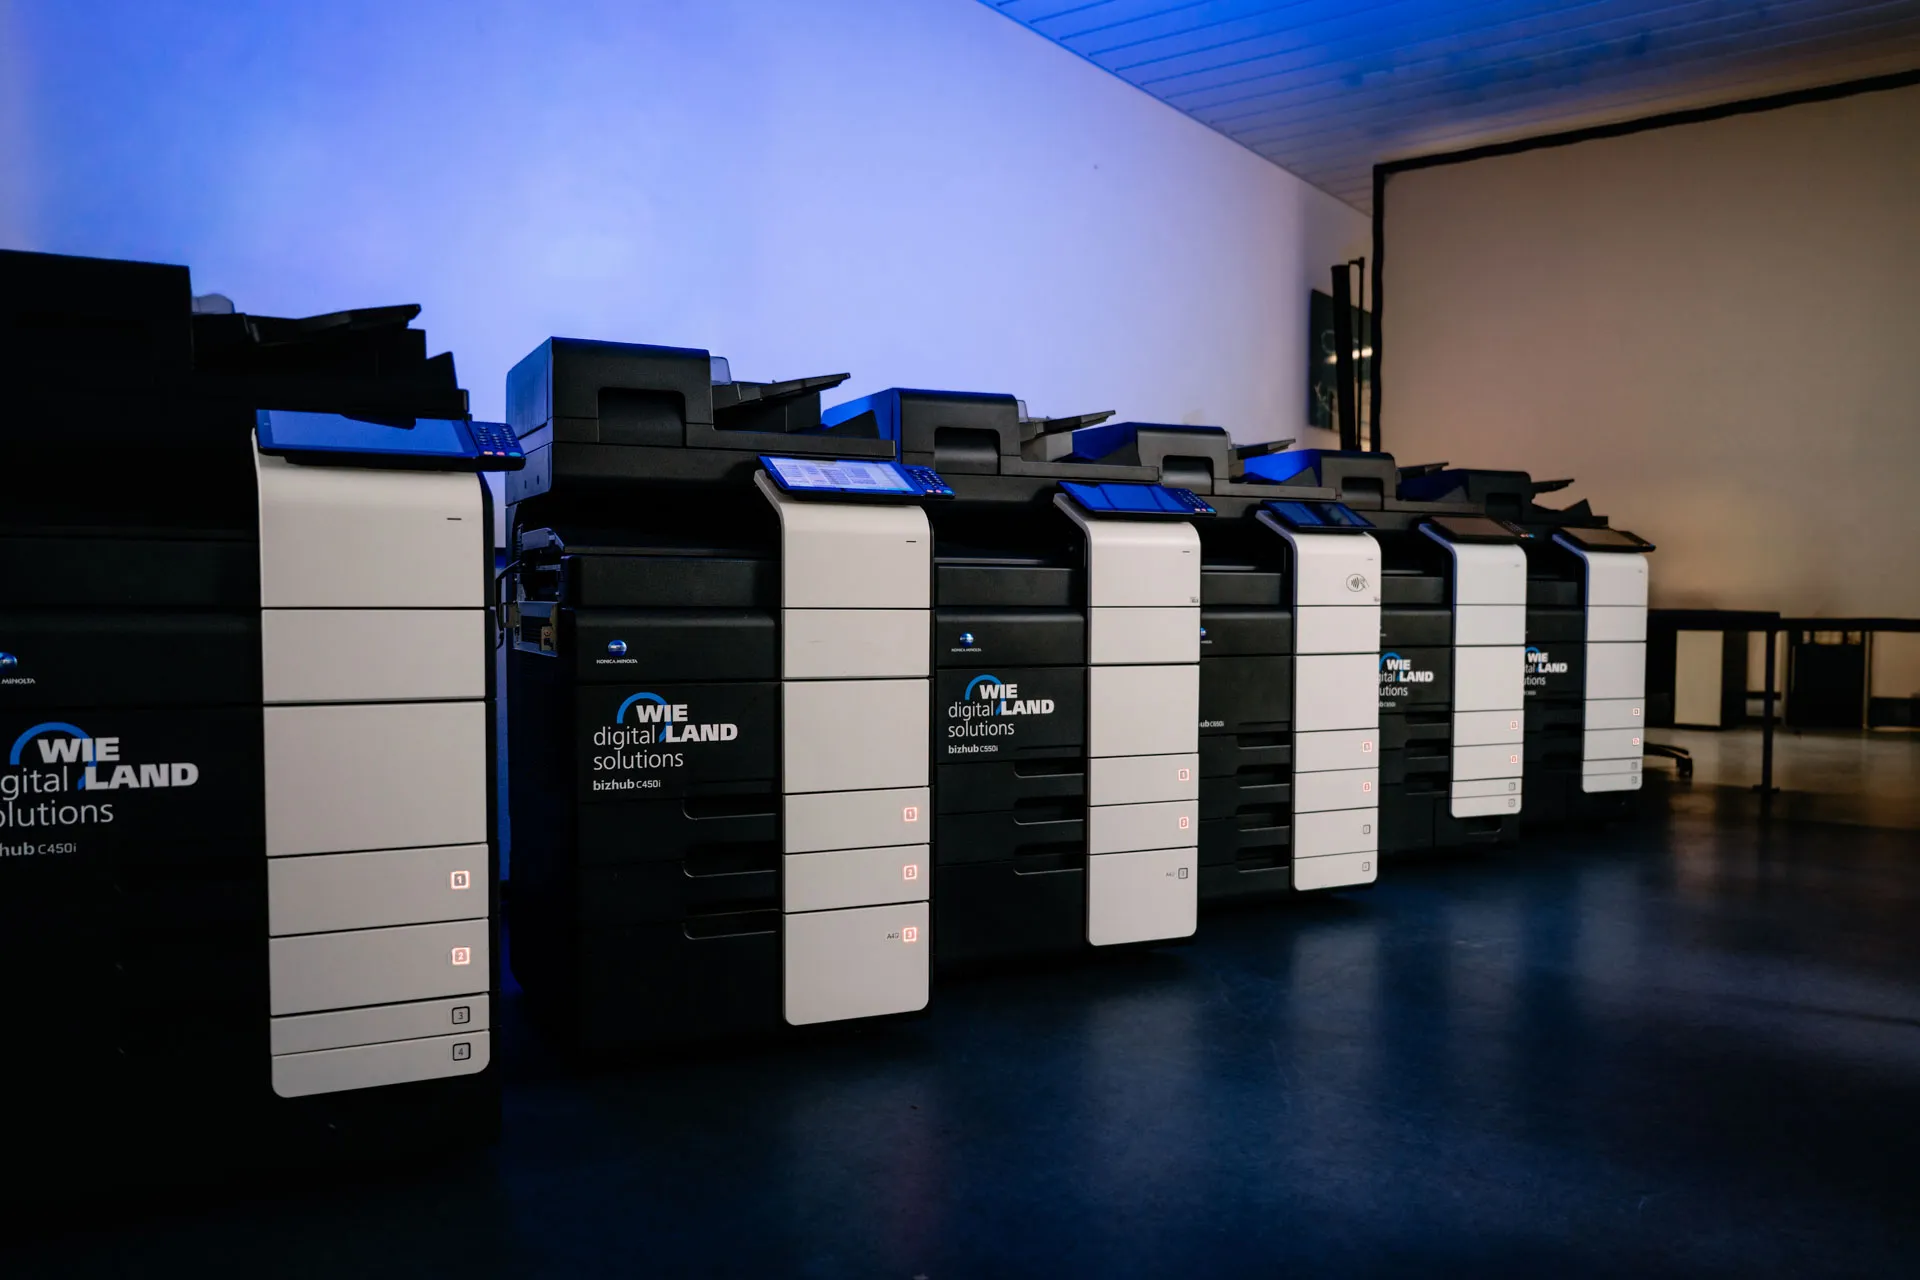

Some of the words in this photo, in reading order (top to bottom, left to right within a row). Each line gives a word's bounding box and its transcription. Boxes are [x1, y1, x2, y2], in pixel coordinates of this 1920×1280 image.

[1386, 659, 1411, 671] WIE
[1527, 653, 1548, 662] WIE
[1537, 662, 1568, 673] LAND
[1399, 671, 1434, 683] LAND
[979, 683, 1018, 699] WIE
[1379, 684, 1409, 697] utions
[636, 704, 688, 723] WIE
[948, 700, 994, 721] digital
[1000, 699, 1055, 716] LAND
[665, 723, 738, 743] LAND
[948, 720, 1015, 737] solutions
[593, 725, 655, 750] digital
[37, 737, 120, 764] WIE
[948, 744, 980, 754] bizhub
[593, 750, 684, 771] solutions
[0, 766, 68, 801] gital
[85, 762, 199, 790] LAND
[593, 778, 635, 791] bizhub
[636, 780, 661, 789] C450i
[0, 800, 114, 827] lutions
[0, 842, 35, 857] hub
[37, 843, 77, 855] C450i
